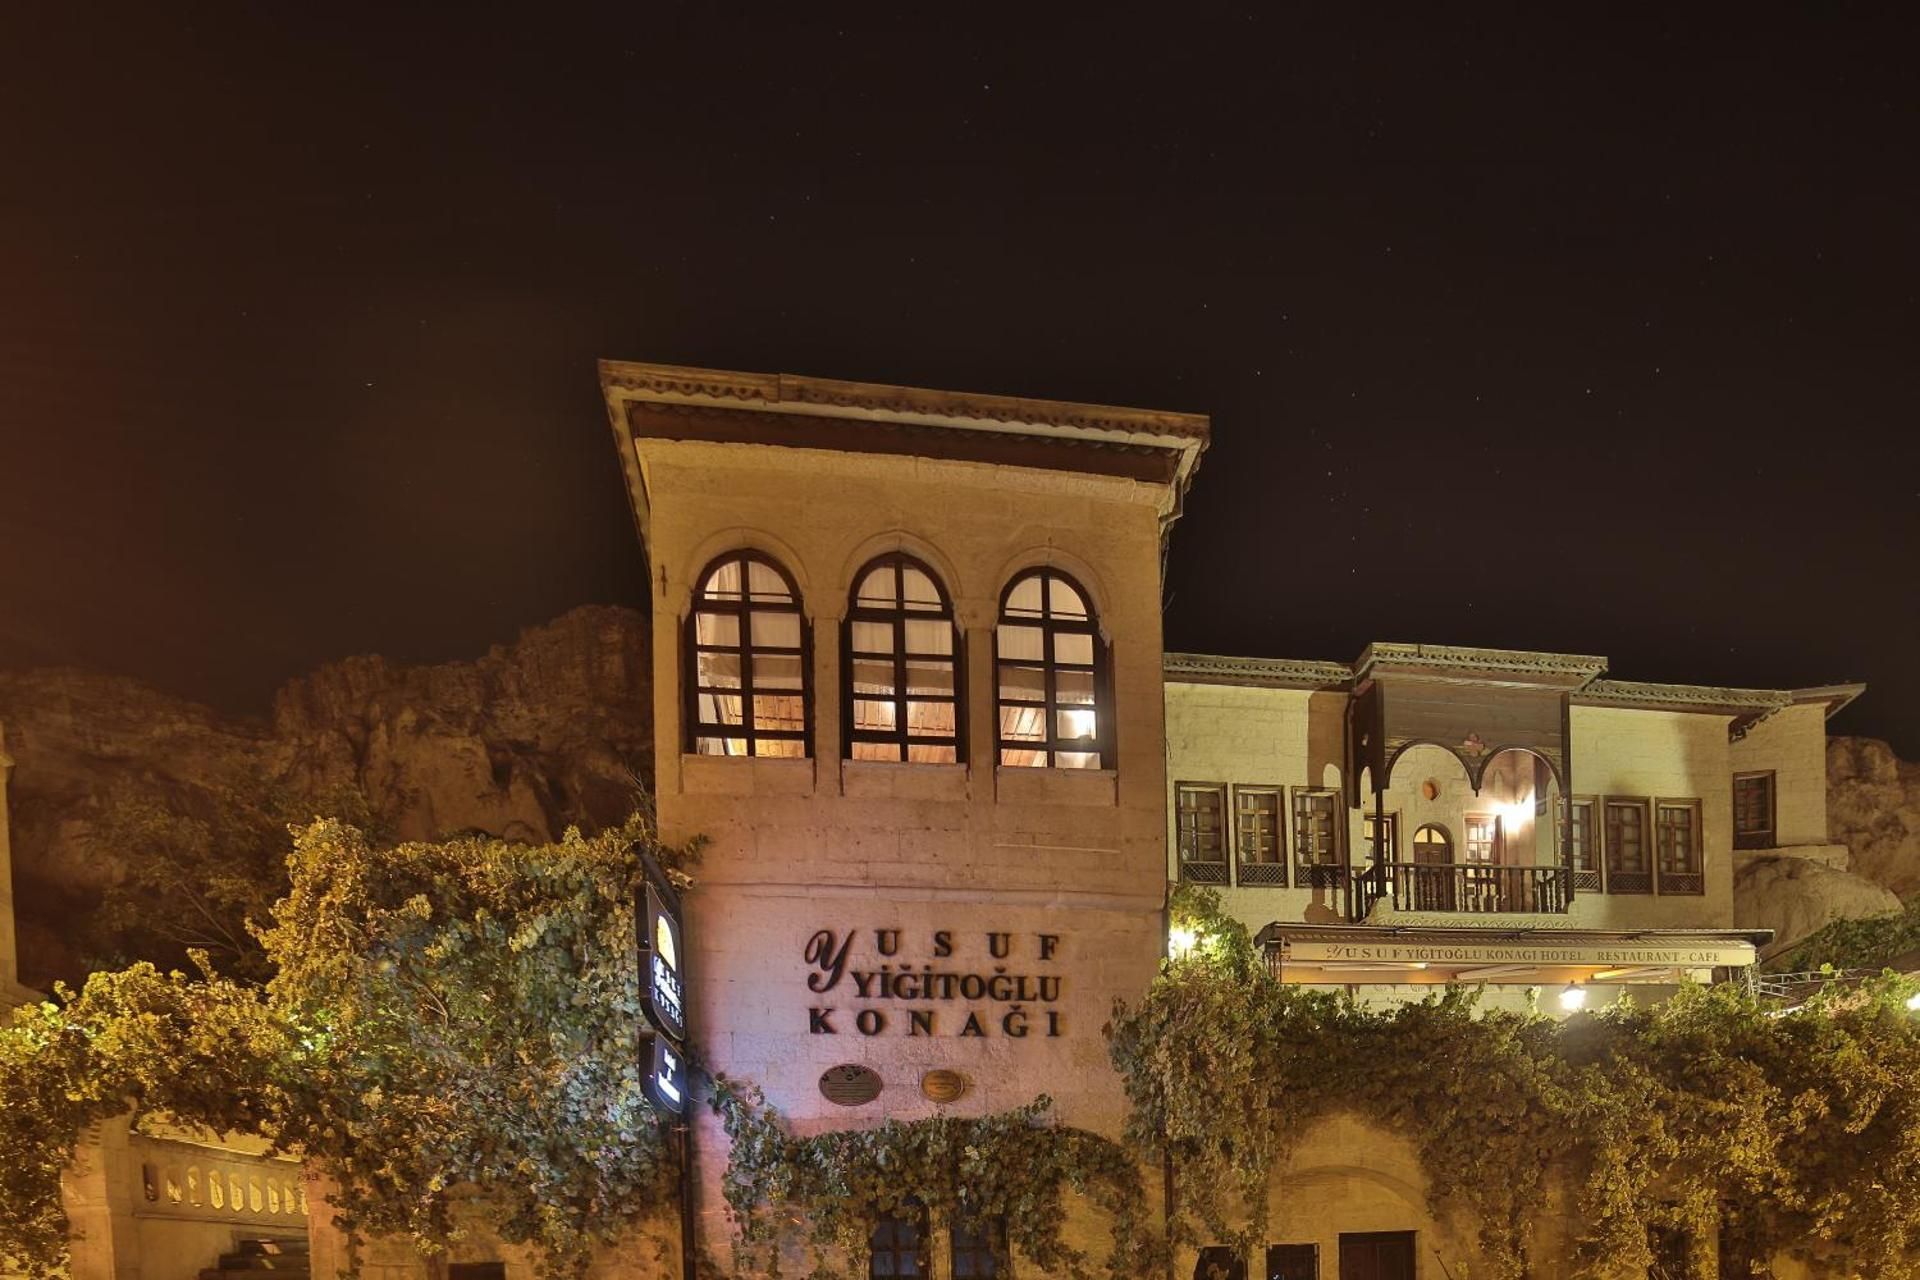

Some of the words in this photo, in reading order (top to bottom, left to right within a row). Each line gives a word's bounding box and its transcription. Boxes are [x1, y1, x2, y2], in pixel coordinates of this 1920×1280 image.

[804, 929, 1061, 994] YUSUF
[1326, 944, 1402, 959] YUSUF
[1540, 951, 1585, 961] HOTEL
[1597, 951, 1679, 962] RESTAURANT
[1689, 952, 1720, 962] CAFE
[849, 964, 1062, 1002] YİĞİTOĞLU
[807, 1004, 1062, 1037] KONAĞI
